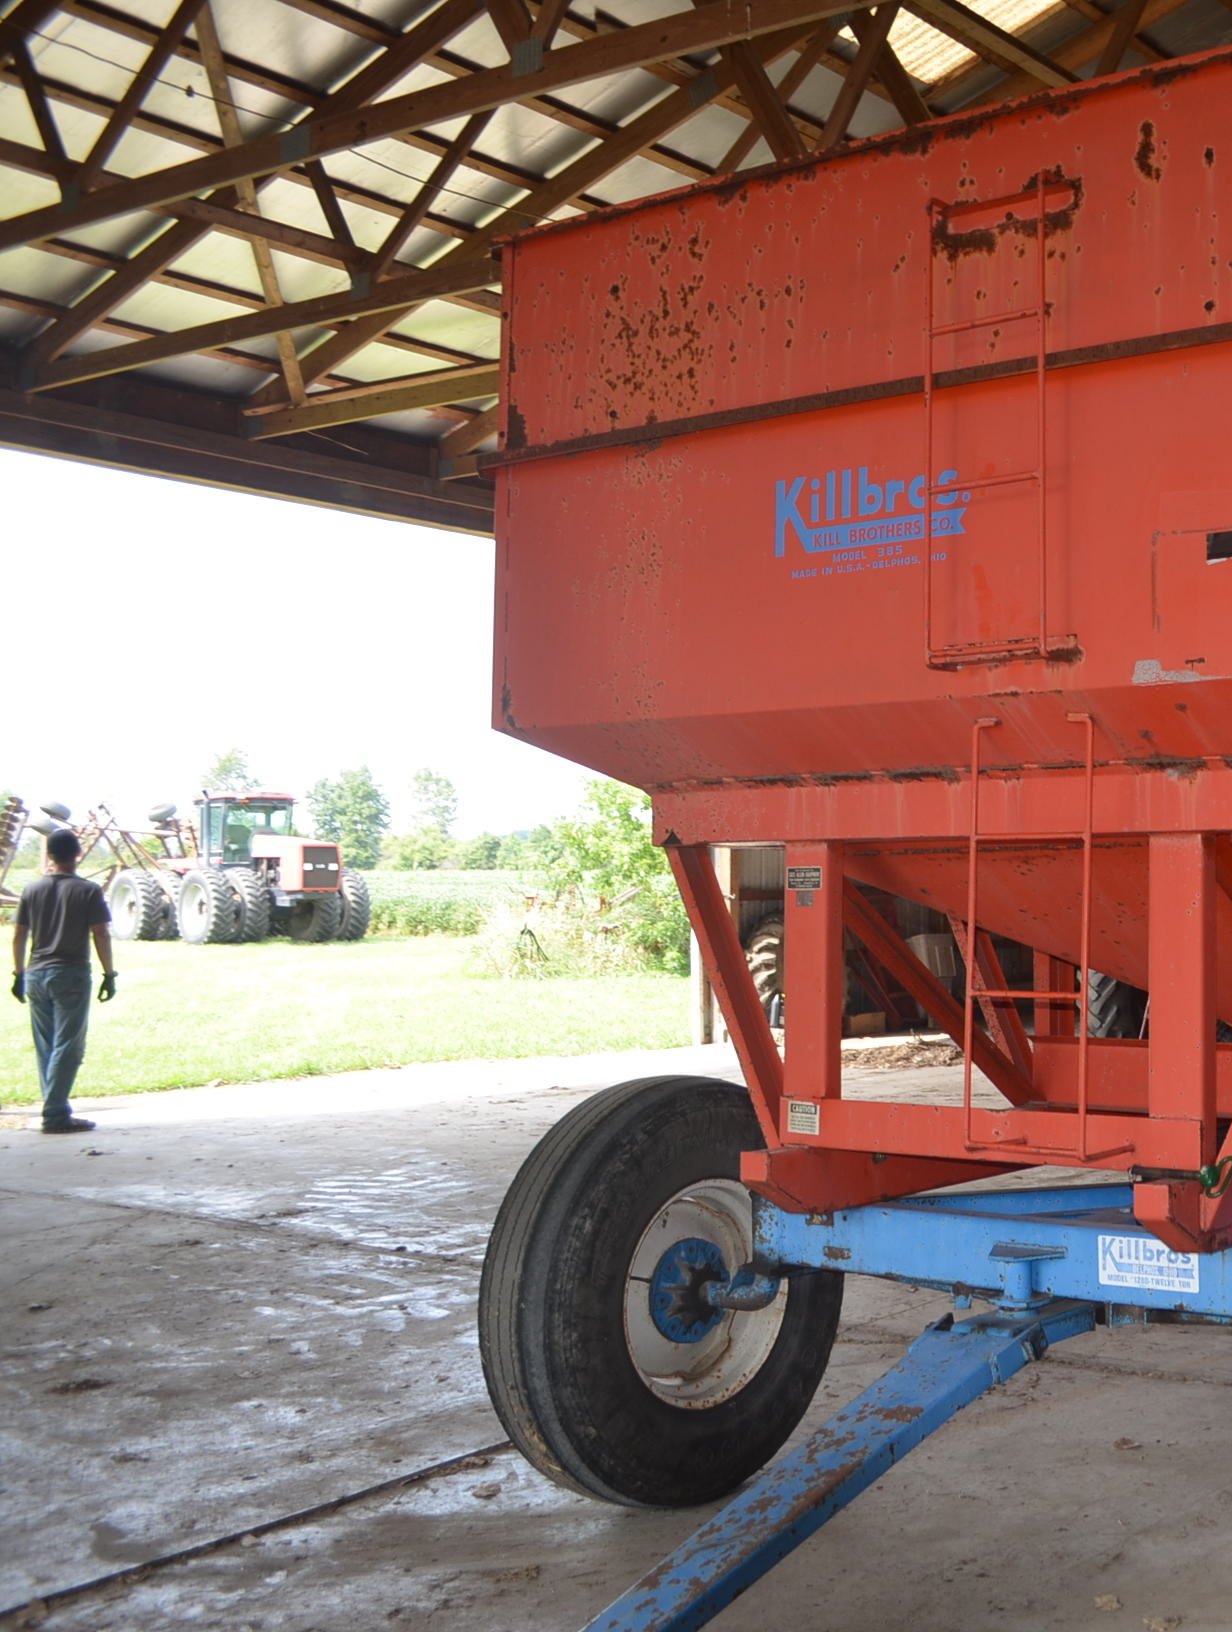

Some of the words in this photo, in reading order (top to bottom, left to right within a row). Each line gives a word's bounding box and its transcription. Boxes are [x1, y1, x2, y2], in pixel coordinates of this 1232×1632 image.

[813, 531, 841, 548] KILL
[849, 519, 921, 544] BROTHERS
[930, 516, 955, 533] CO.
[832, 550, 867, 563] MODEL
[792, 568, 817, 580] MADE
[821, 566, 833, 576] IN
[1107, 1274, 1128, 1283] MODEL
